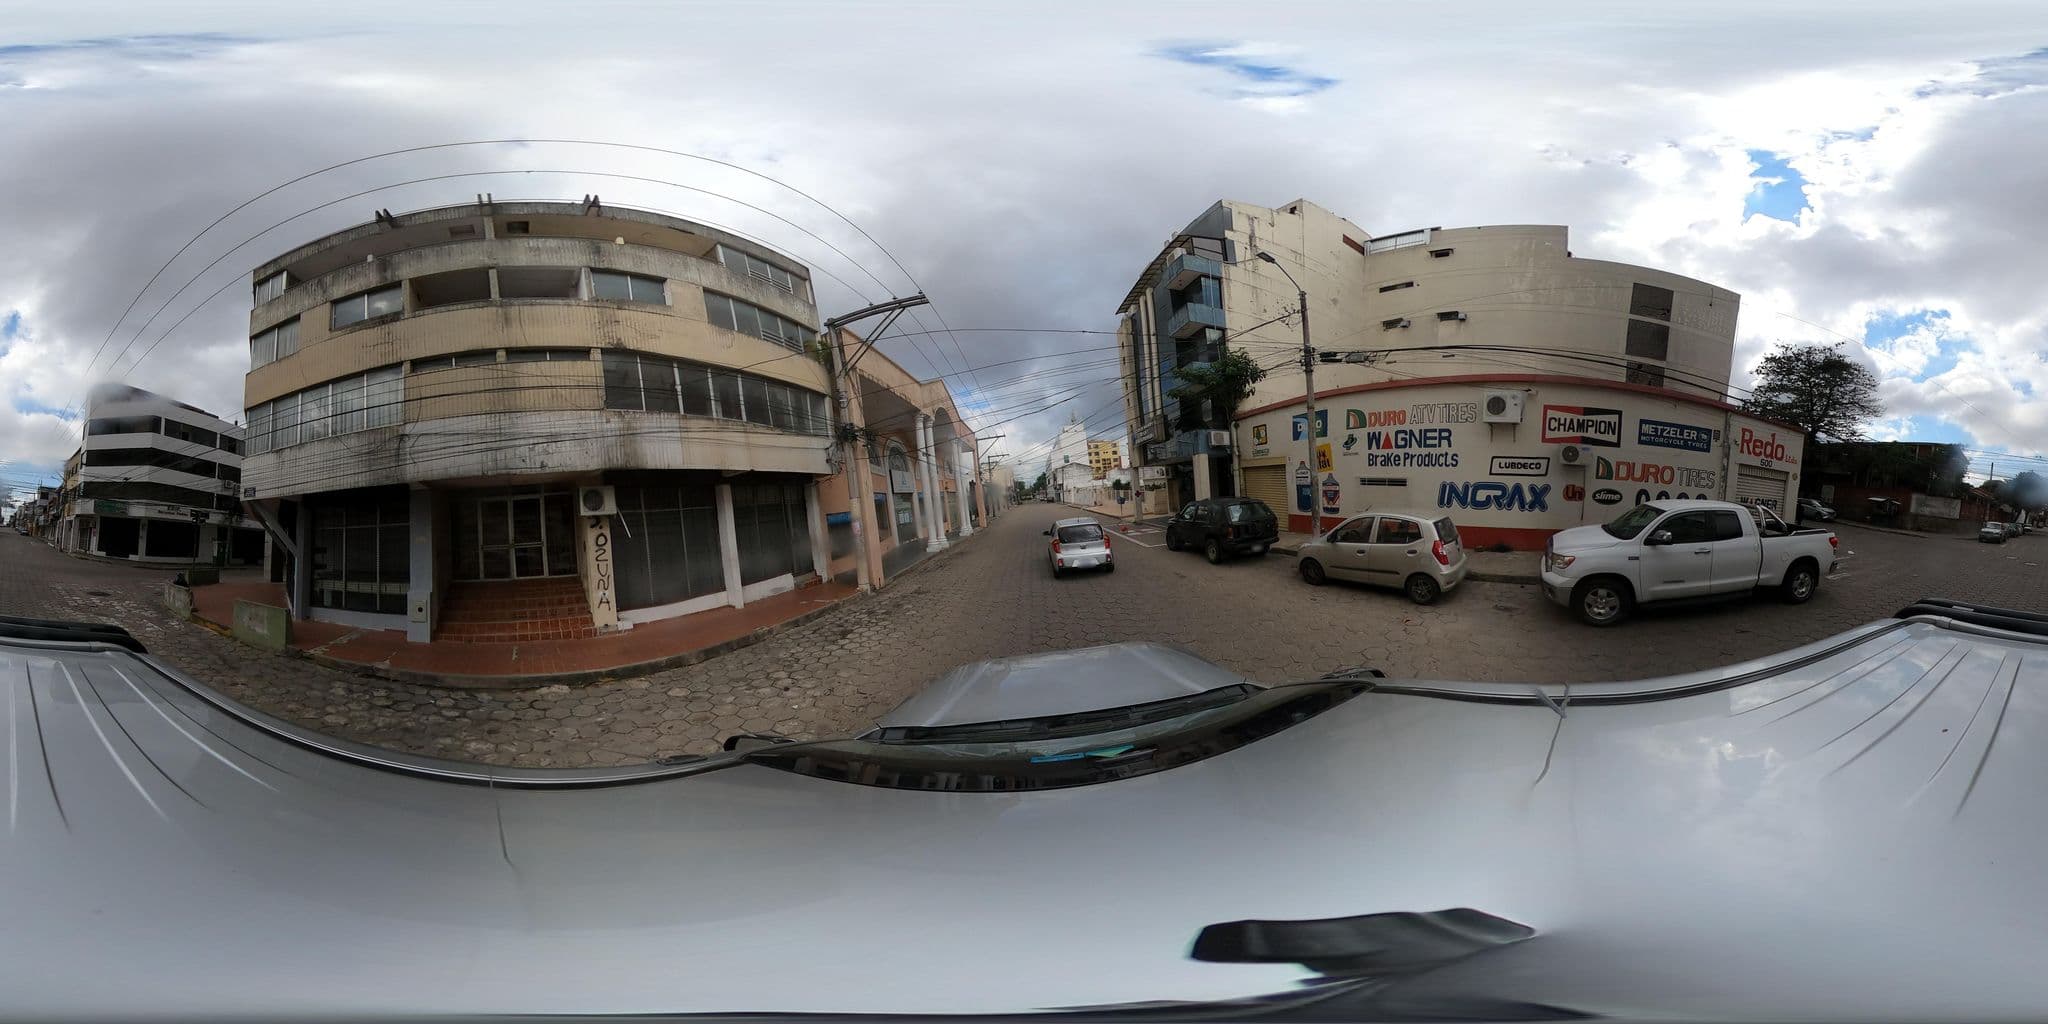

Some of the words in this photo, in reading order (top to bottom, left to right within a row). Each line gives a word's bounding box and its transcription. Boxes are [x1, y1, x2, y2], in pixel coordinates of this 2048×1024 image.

[1368, 410, 1407, 427] DURO
[1409, 403, 1436, 424] ATV
[1437, 402, 1477, 424] TIRES
[1548, 417, 1617, 436] CHAMPION
[1641, 423, 1698, 440] METZELER
[1367, 428, 1453, 450] WAGNER
[1739, 427, 1785, 461] Redo
[1367, 452, 1401, 467] Brake
[1403, 451, 1459, 468] Products
[1498, 461, 1542, 470] LUBDECO
[1760, 458, 1773, 467] 500
[1614, 460, 1675, 484] DURO
[1677, 466, 1716, 489] TIRES
